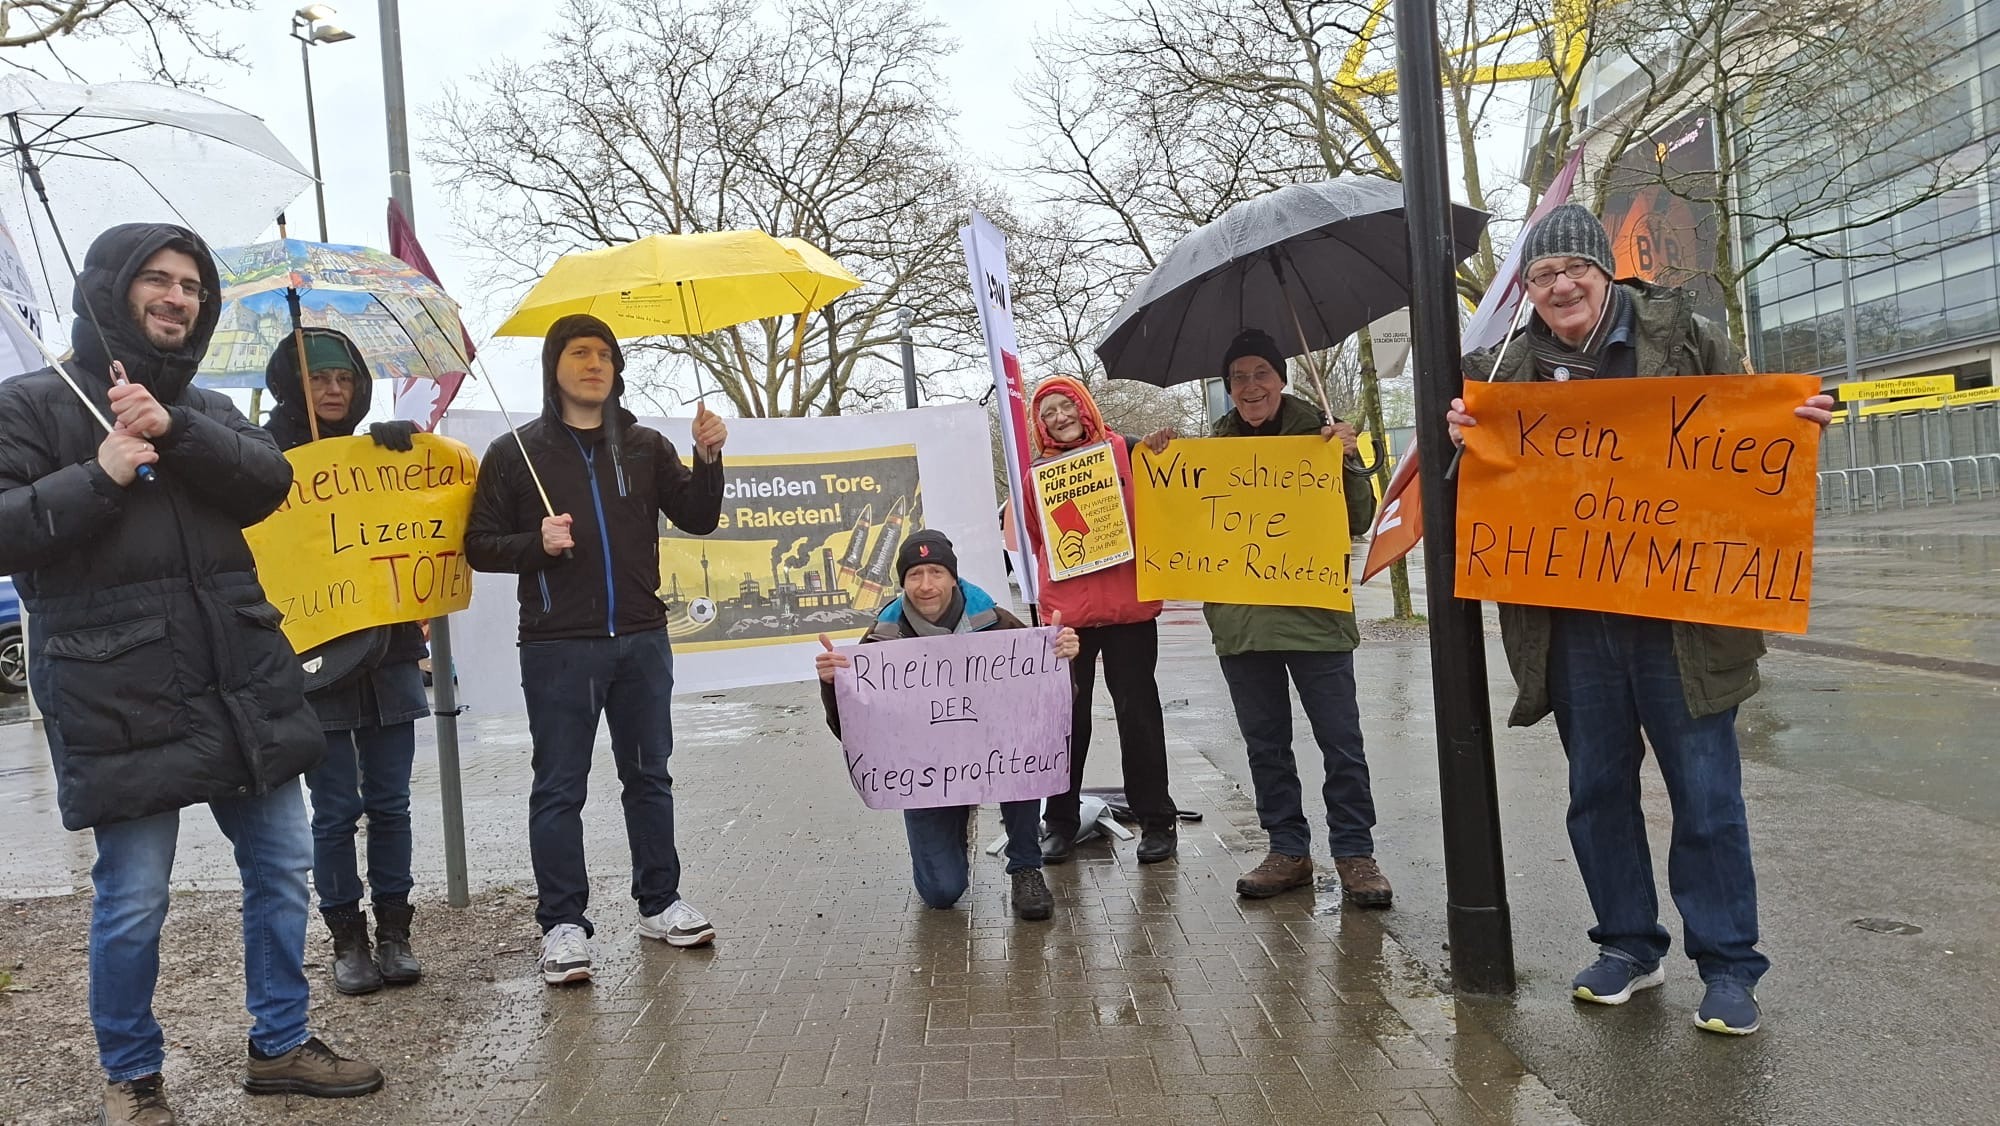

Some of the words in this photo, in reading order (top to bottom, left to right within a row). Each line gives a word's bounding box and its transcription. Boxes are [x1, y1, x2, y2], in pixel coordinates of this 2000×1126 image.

[1858, 389, 1888, 398] Eingang
[1890, 386, 1935, 396] Nordtribüne
[1936, 392, 1967, 401] EIGANG
[1517, 410, 1623, 461] Kein
[1667, 394, 1795, 496] Krieg
[724, 476, 816, 499] chießen
[820, 473, 881, 495] Tore,
[1039, 464, 1067, 481] ROTE
[1070, 451, 1105, 471] KARTE
[1045, 478, 1066, 493] FÜR
[1069, 469, 1093, 486] DEN
[1141, 452, 1208, 489] Wir
[1227, 453, 1343, 496] schießen
[1044, 476, 1114, 507] WERBEDEAL!
[1574, 477, 1679, 525] ohne
[330, 513, 447, 554] Lizenz
[736, 503, 842, 528] Raketen!
[1201, 494, 1291, 538] Tore
[1239, 543, 1351, 594] Raketen!
[1467, 522, 1806, 602] RHEINMETALL
[281, 579, 362, 626] zum
[930, 696, 977, 720] DER
[844, 735, 1071, 797] Kriegsprofiteur!
